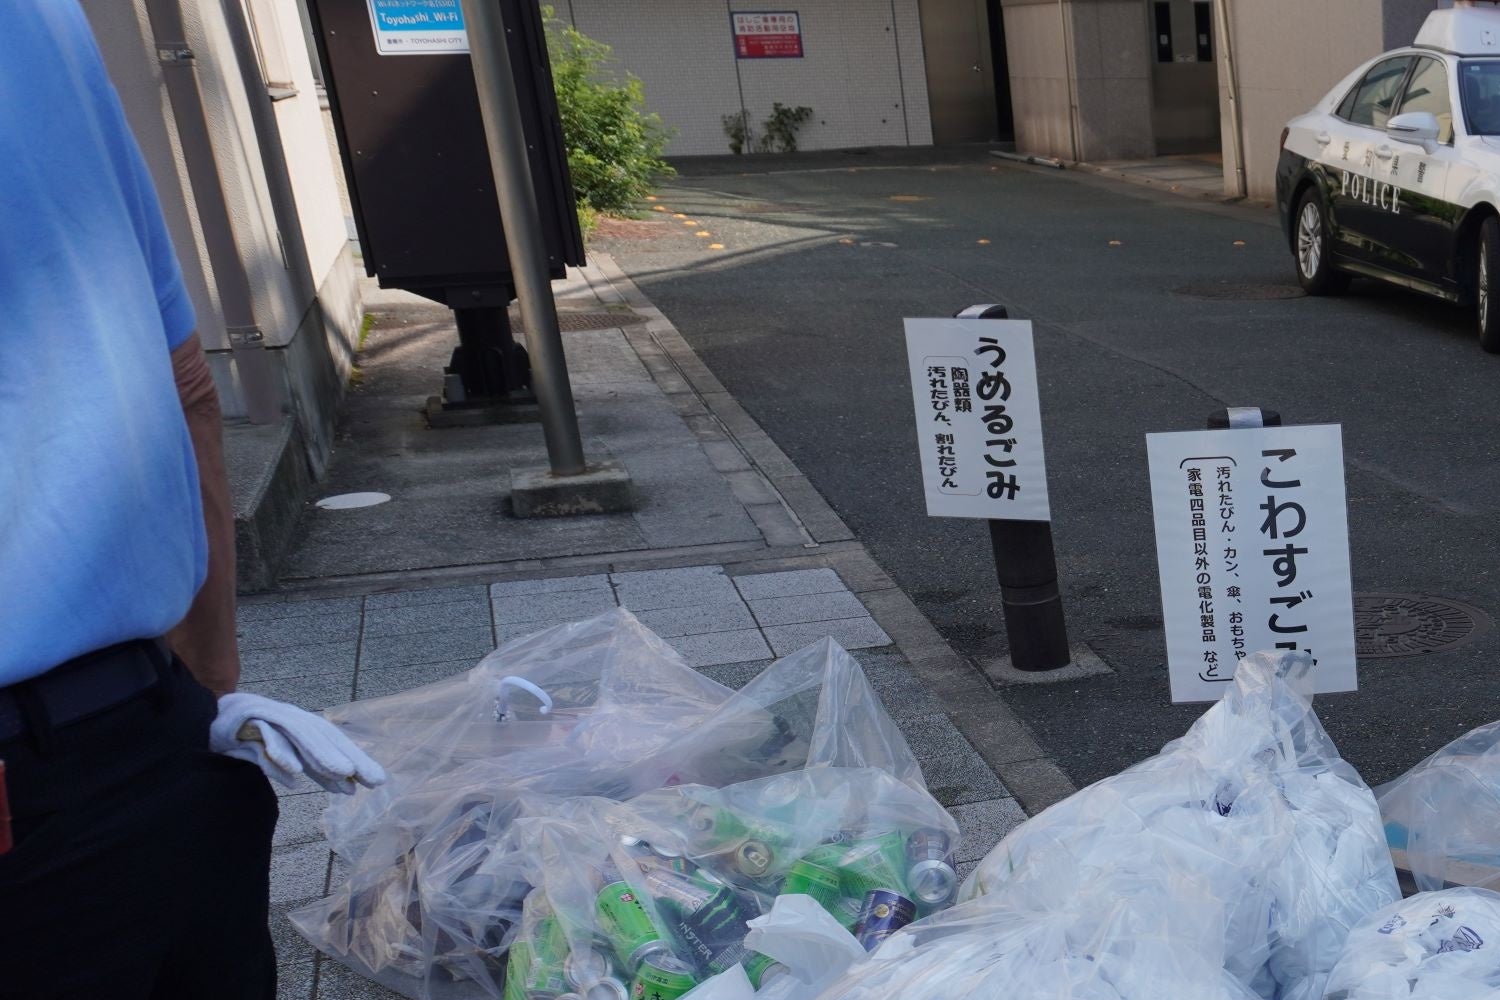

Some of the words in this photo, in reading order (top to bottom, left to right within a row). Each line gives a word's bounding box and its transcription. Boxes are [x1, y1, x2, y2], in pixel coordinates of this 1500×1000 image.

[1341, 170, 1400, 214] POLICE
[951, 366, 972, 413] 陶器類
[974, 337, 1020, 501] うめるごみ
